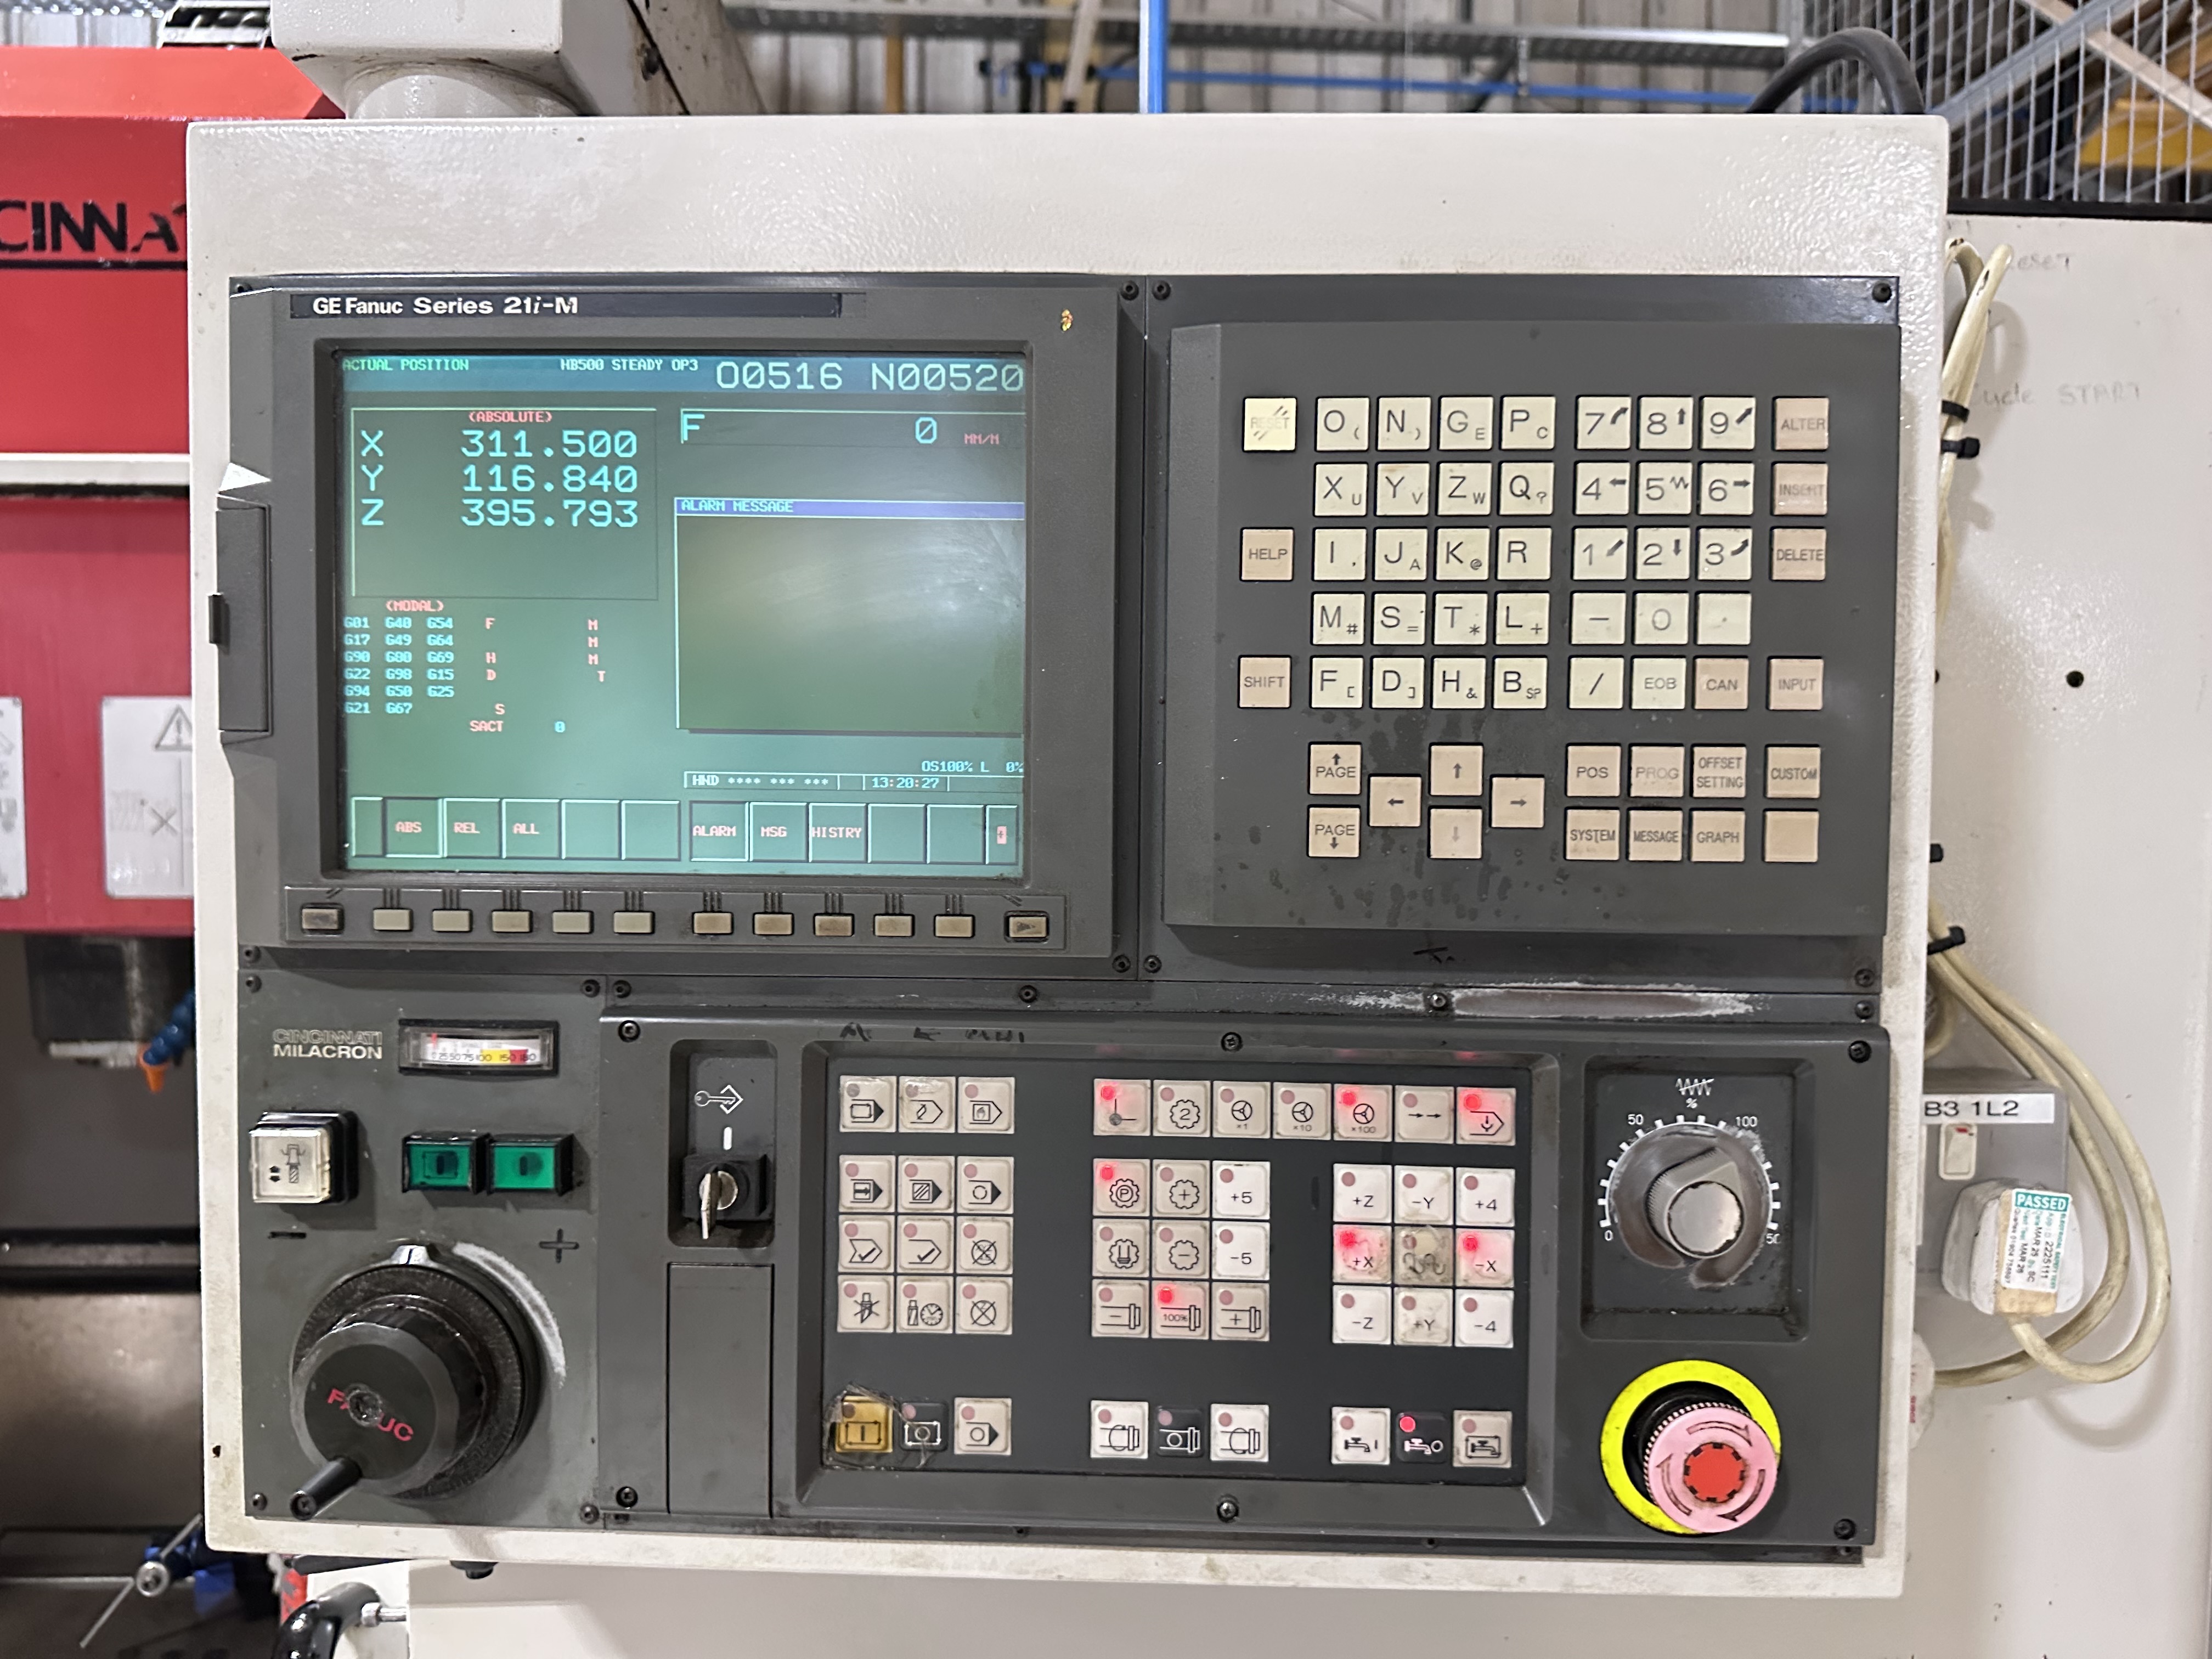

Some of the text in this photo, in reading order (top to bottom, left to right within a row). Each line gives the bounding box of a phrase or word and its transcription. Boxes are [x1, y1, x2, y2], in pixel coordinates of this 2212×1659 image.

[312, 296, 578, 315] GE Fanuc Series 21i-M
[342, 358, 470, 371] ACTUAL POSITION
[611, 358, 663, 371] STEADY
[671, 358, 698, 371] OP3
[871, 362, 1024, 392] N00520
[469, 410, 553, 423] (ABSOLUTE)
[1386, 409, 1406, 433] N
[1446, 410, 1469, 433] G
[1509, 409, 1530, 432] P
[1647, 411, 1668, 435] 8
[1709, 411, 1729, 435] 9
[683, 413, 706, 442] F
[915, 416, 1000, 445] 0 MM/M
[1584, 412, 1605, 436] 7
[1780, 417, 1826, 431] ALTER
[1536, 427, 1548, 439] C
[360, 430, 638, 458] X 311.500
[360, 464, 638, 493] Y 116.840
[1323, 476, 1342, 499] X
[1385, 476, 1405, 499] Y
[1448, 476, 1466, 498] Z
[1509, 475, 1531, 500] Q
[1581, 477, 1602, 501] 4
[1645, 477, 1664, 500] 5
[1708, 478, 1728, 502] 6
[1779, 483, 1825, 496] INSERT
[1472, 493, 1486, 505] W
[681, 499, 794, 513] ALARM MESSAGE
[360, 498, 639, 528] Z 395.793
[1248, 549, 1288, 560] HELP
[1384, 540, 1403, 565] J
[1445, 540, 1464, 565] K
[1506, 540, 1527, 564] R
[1582, 543, 1593, 566] 1
[1643, 543, 1663, 566] 2
[1705, 542, 1725, 565] 3
[1776, 549, 1825, 561] DELETE
[1409, 558, 1421, 571] A
[386, 600, 444, 612] (MODAL)
[1319, 605, 1341, 628] M
[1380, 606, 1401, 629] S
[1443, 605, 1463, 629] T
[1505, 605, 1523, 629] L
[486, 618, 495, 630] F
[587, 619, 599, 630] M
[587, 636, 599, 648] M
[486, 652, 496, 664] H
[587, 654, 599, 665] M
[486, 669, 496, 681] D
[597, 670, 606, 682] T
[1319, 670, 1338, 692] F
[1382, 670, 1401, 692] D
[1441, 670, 1461, 693] H
[1503, 670, 1522, 693] B
[1243, 675, 1285, 689] SHIFT
[1644, 677, 1677, 690] EOB
[1706, 679, 1739, 691] CAN
[1778, 678, 1818, 691] INPUT
[495, 703, 505, 715] S
[470, 720, 504, 732] SACT
[980, 761, 990, 773] L
[1698, 757, 1742, 769] OFFSET
[1316, 766, 1357, 778] PAGE
[1576, 766, 1609, 778] POS
[1635, 767, 1679, 780] PROG
[1770, 768, 1817, 780] CUSTOM
[692, 775, 719, 786] HND
[871, 776, 940, 789] 13:20:27
[1696, 776, 1743, 789] SETTING
[395, 821, 422, 833] ABS
[453, 822, 481, 834] REL
[512, 822, 540, 835] ALL
[692, 826, 737, 837] ALARM
[760, 827, 787, 838] MSG
[812, 826, 862, 839] HISTRY
[1314, 823, 1356, 836] PAGE
[1570, 829, 1616, 843] SYSTEM
[1633, 831, 1679, 843] MESSAGE
[1696, 832, 1740, 843] GRAPH
[273, 1029, 382, 1044] CINCINNATI
[274, 1046, 382, 1059] MILACRON
[1925, 1101, 1959, 1116] B3
[1628, 1114, 1644, 1125] 50
[1735, 1116, 1758, 1127] 100
[1231, 1192, 1253, 1204] +5
[1352, 1195, 1374, 1207] +Z
[1412, 1197, 1435, 1209] -Y
[2017, 1193, 2066, 1210] PASSED
[1475, 1199, 1497, 1211] +4
[1230, 1252, 1252, 1265] -5
[1352, 1256, 1373, 1268] +X
[1475, 1260, 1497, 1272] -X
[1352, 1317, 1374, 1329] -Z
[1414, 1319, 1435, 1330] +Y
[1474, 1321, 1497, 1332] -4
[328, 1389, 413, 1441] FUC
